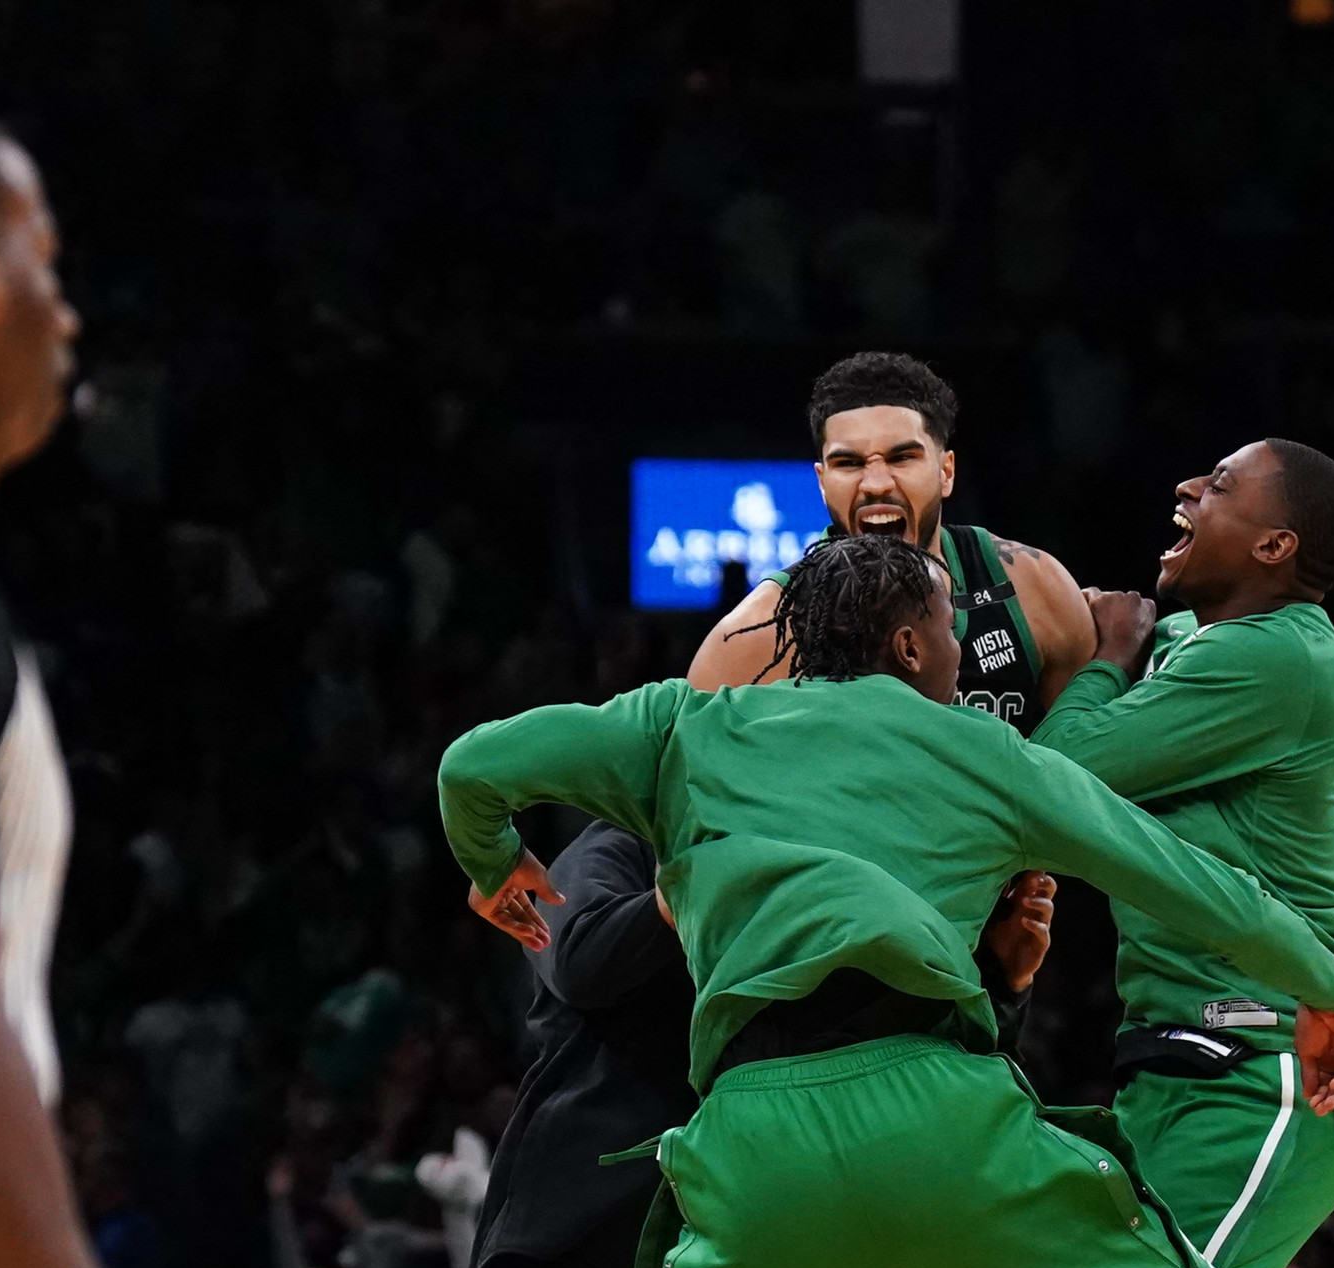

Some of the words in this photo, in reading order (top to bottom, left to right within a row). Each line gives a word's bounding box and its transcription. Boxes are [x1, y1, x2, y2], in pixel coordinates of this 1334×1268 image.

[973, 590, 992, 604] 24
[973, 629, 1013, 659] VISTA
[979, 647, 1017, 674] PRINT
